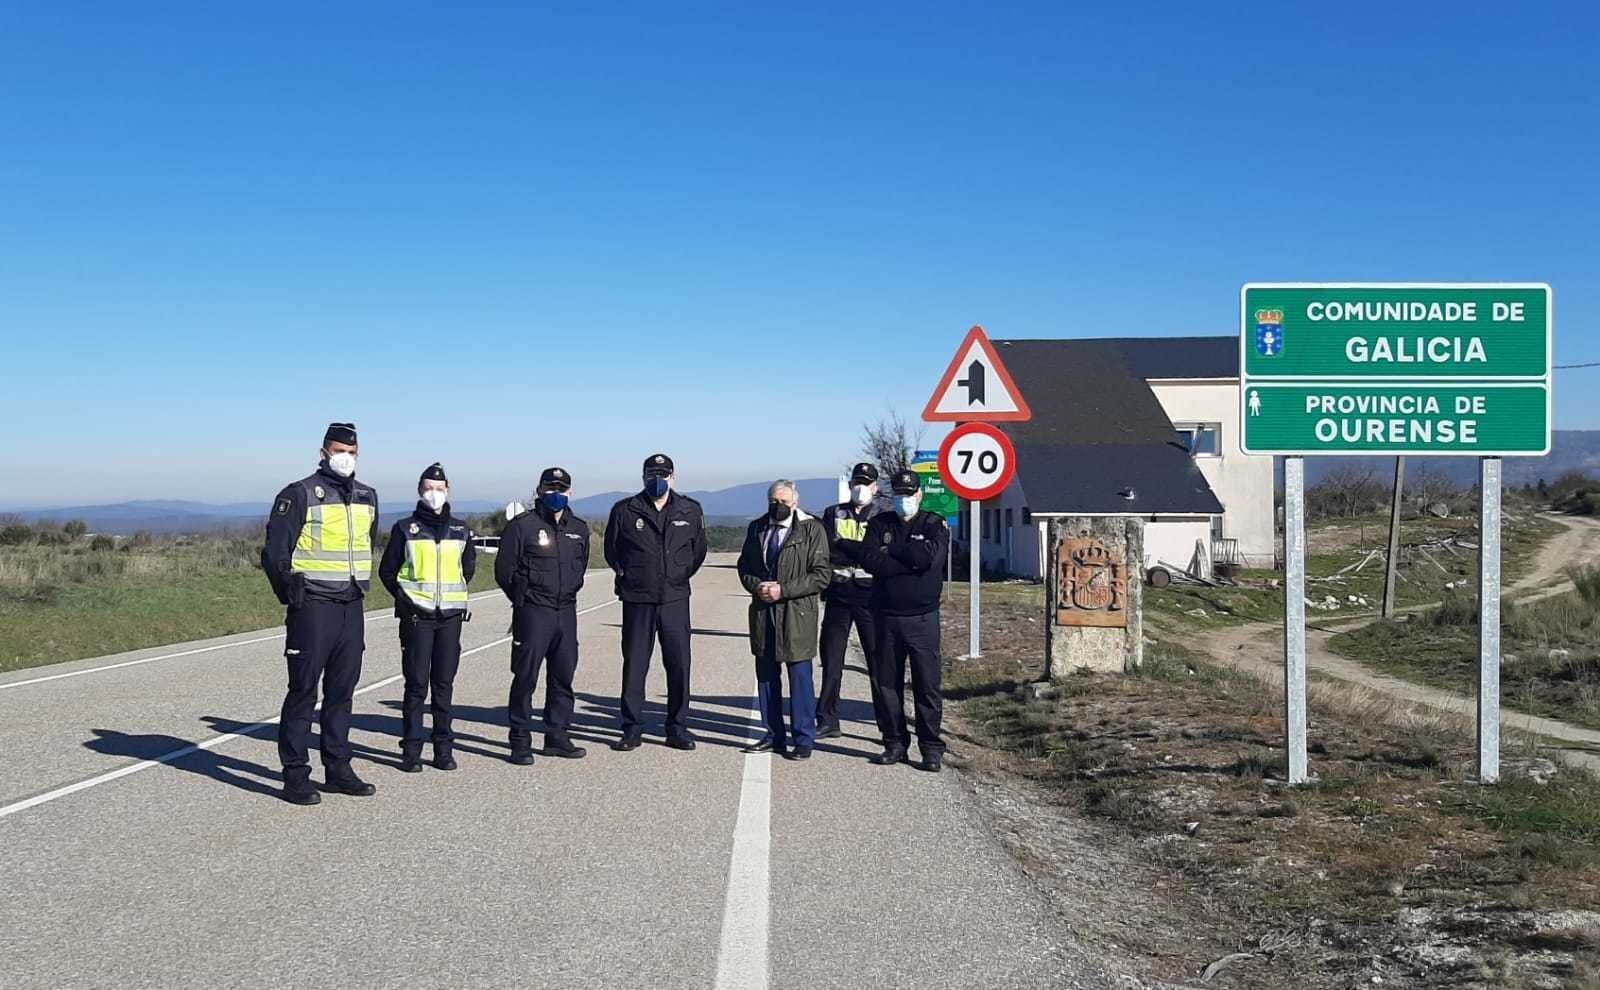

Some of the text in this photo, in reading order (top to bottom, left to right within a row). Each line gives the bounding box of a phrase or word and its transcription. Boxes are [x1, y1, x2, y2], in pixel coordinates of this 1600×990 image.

[1306, 302, 1525, 322] COMUNIDADE DE
[1345, 336, 1488, 363] GALICIA
[1305, 395, 1486, 414] PROVINCIA DE
[1314, 419, 1478, 443] OURENSE
[957, 450, 998, 474] 70
